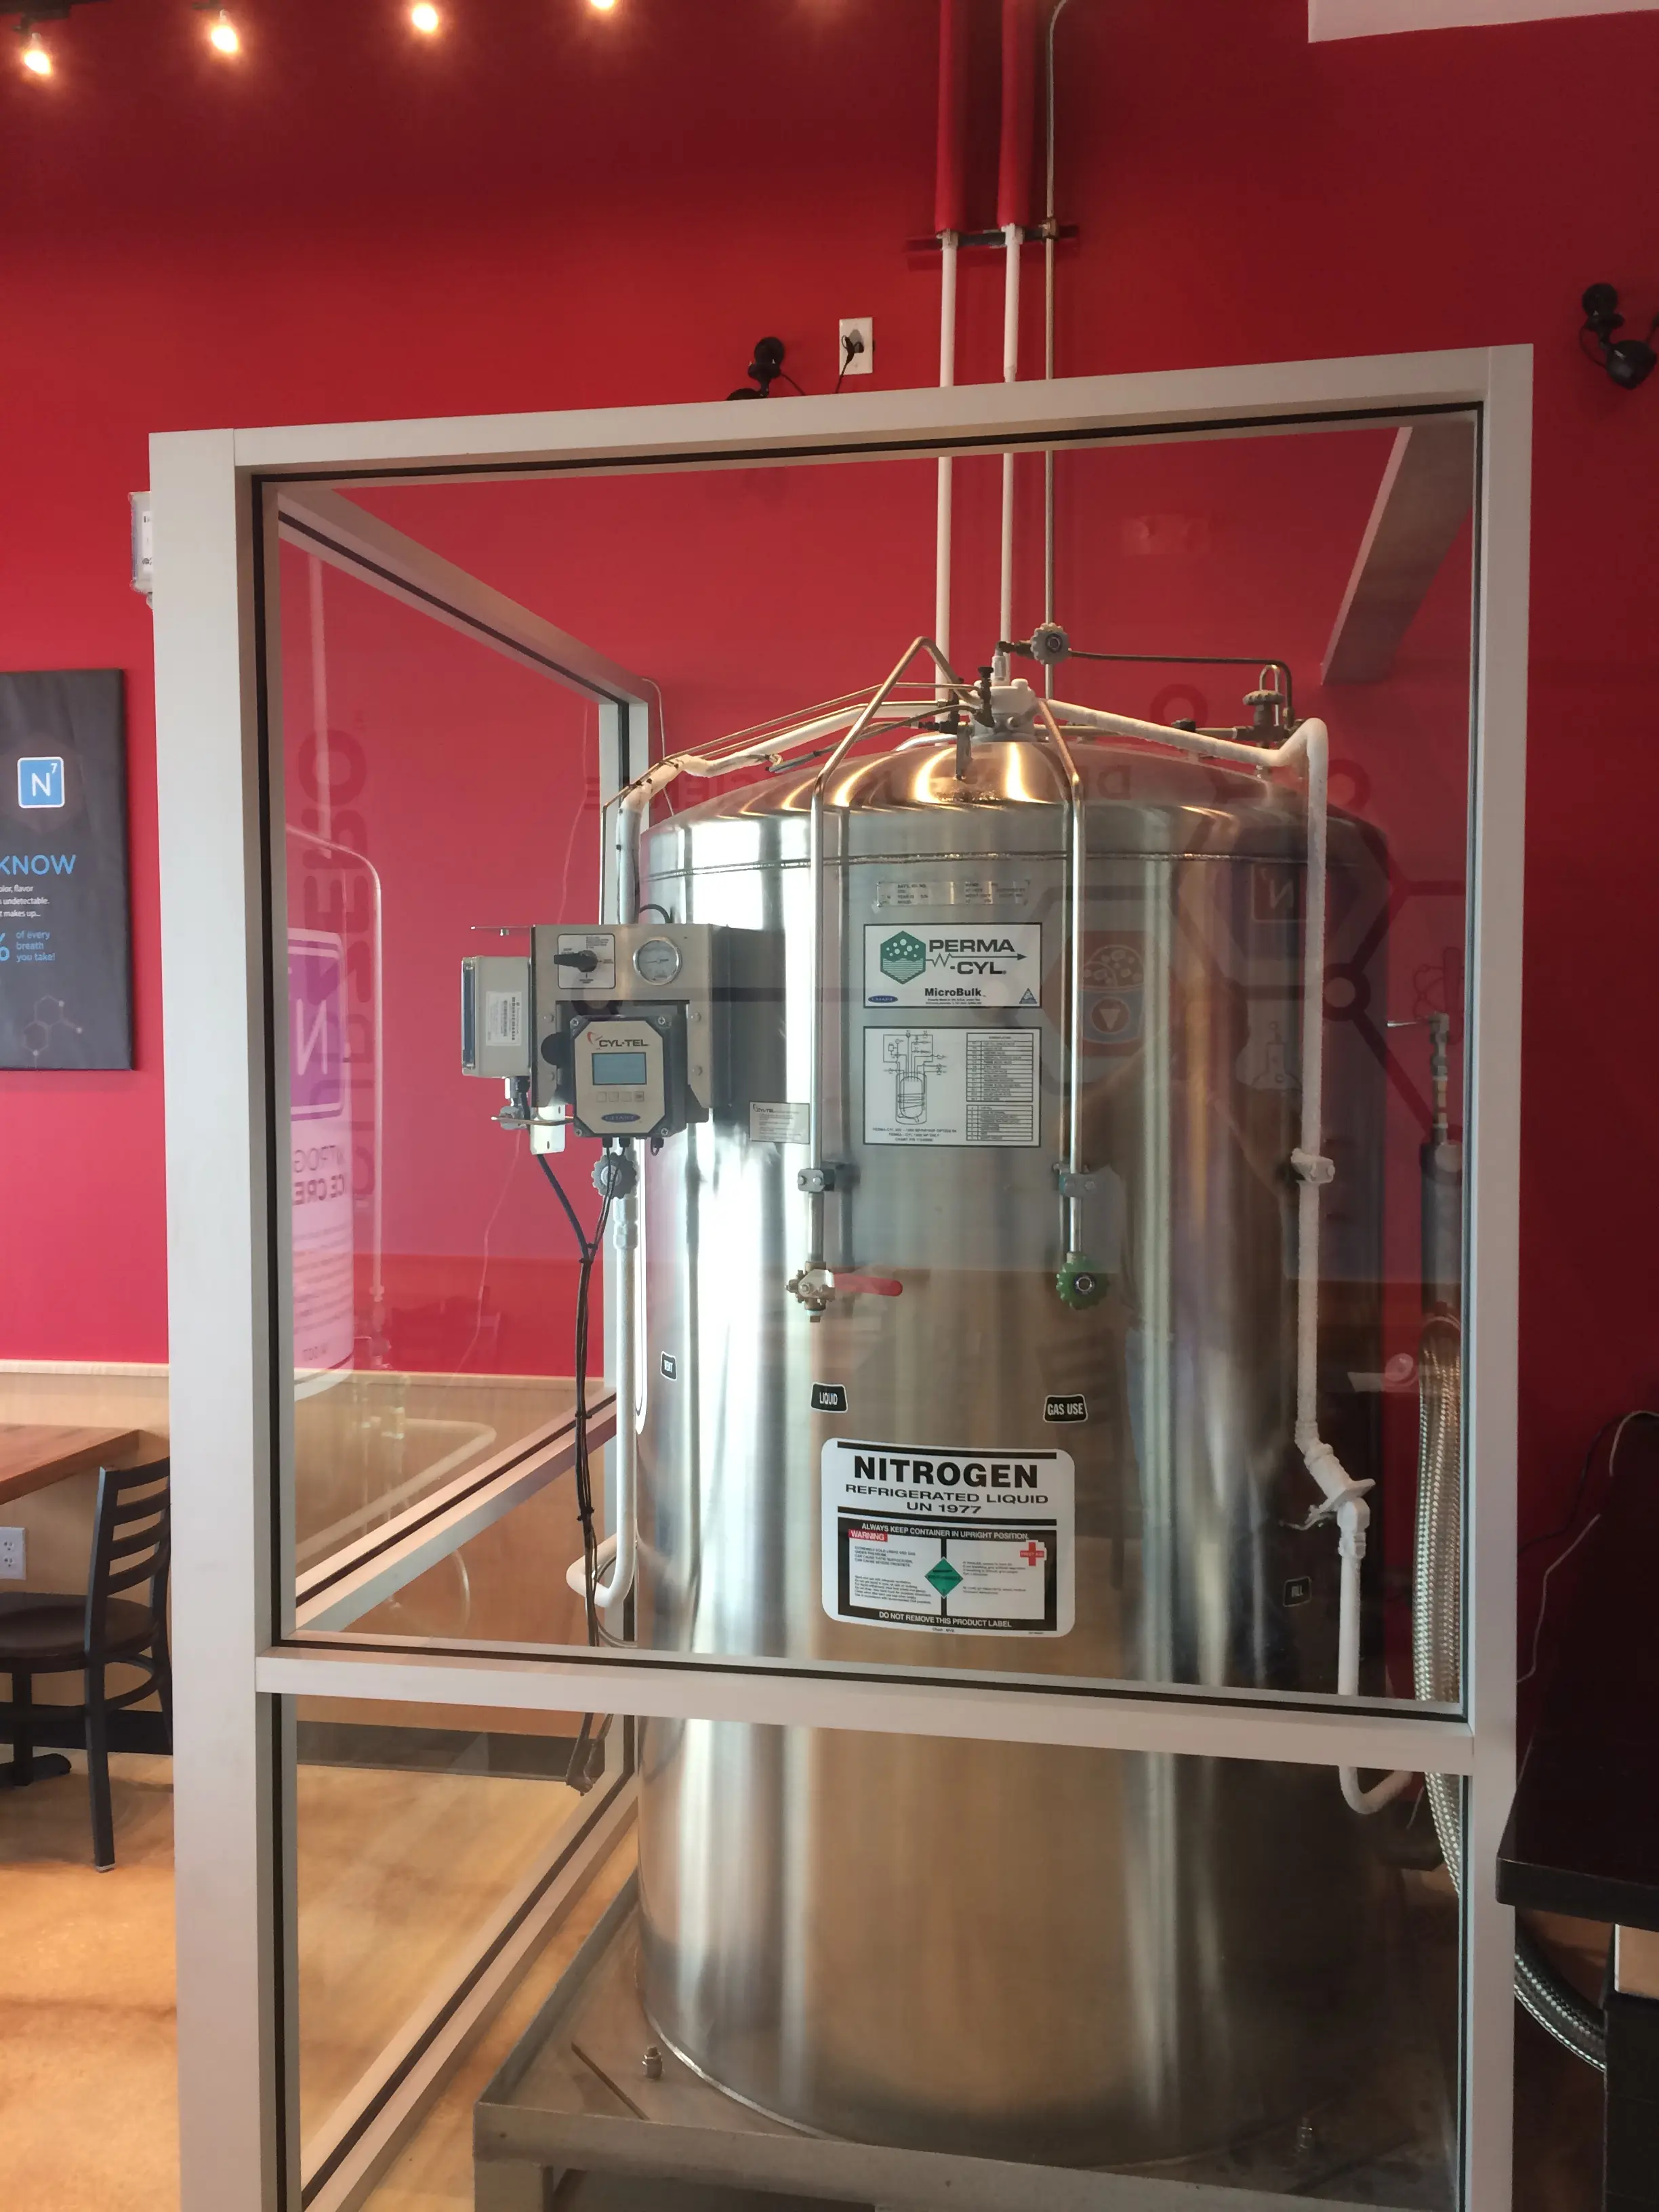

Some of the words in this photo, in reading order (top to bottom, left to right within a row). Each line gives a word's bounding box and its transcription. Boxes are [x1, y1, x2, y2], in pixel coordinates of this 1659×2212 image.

[929, 939, 1015, 953] PERMA
[924, 987, 982, 997] MicroBulk
[819, 1391, 838, 1406] LIQUID
[1047, 1403, 1065, 1415] GAS
[1067, 1403, 1084, 1414] USE
[854, 1455, 1038, 1488] NITROGEN
[845, 1483, 980, 1502] REFRIGERATED
[987, 1494, 1048, 1504] LIQUID
[907, 1501, 933, 1512] UN
[938, 1504, 982, 1514] 1977
[851, 1530, 885, 1541] WARNING
[861, 1523, 889, 1532] ALWAYS
[890, 1525, 909, 1534] KEEP
[909, 1528, 950, 1537] CONTAINER
[960, 1531, 992, 1539] UPRIGHT
[905, 1615, 935, 1623] REMOVE
[952, 1618, 987, 1626] PRODUCT
